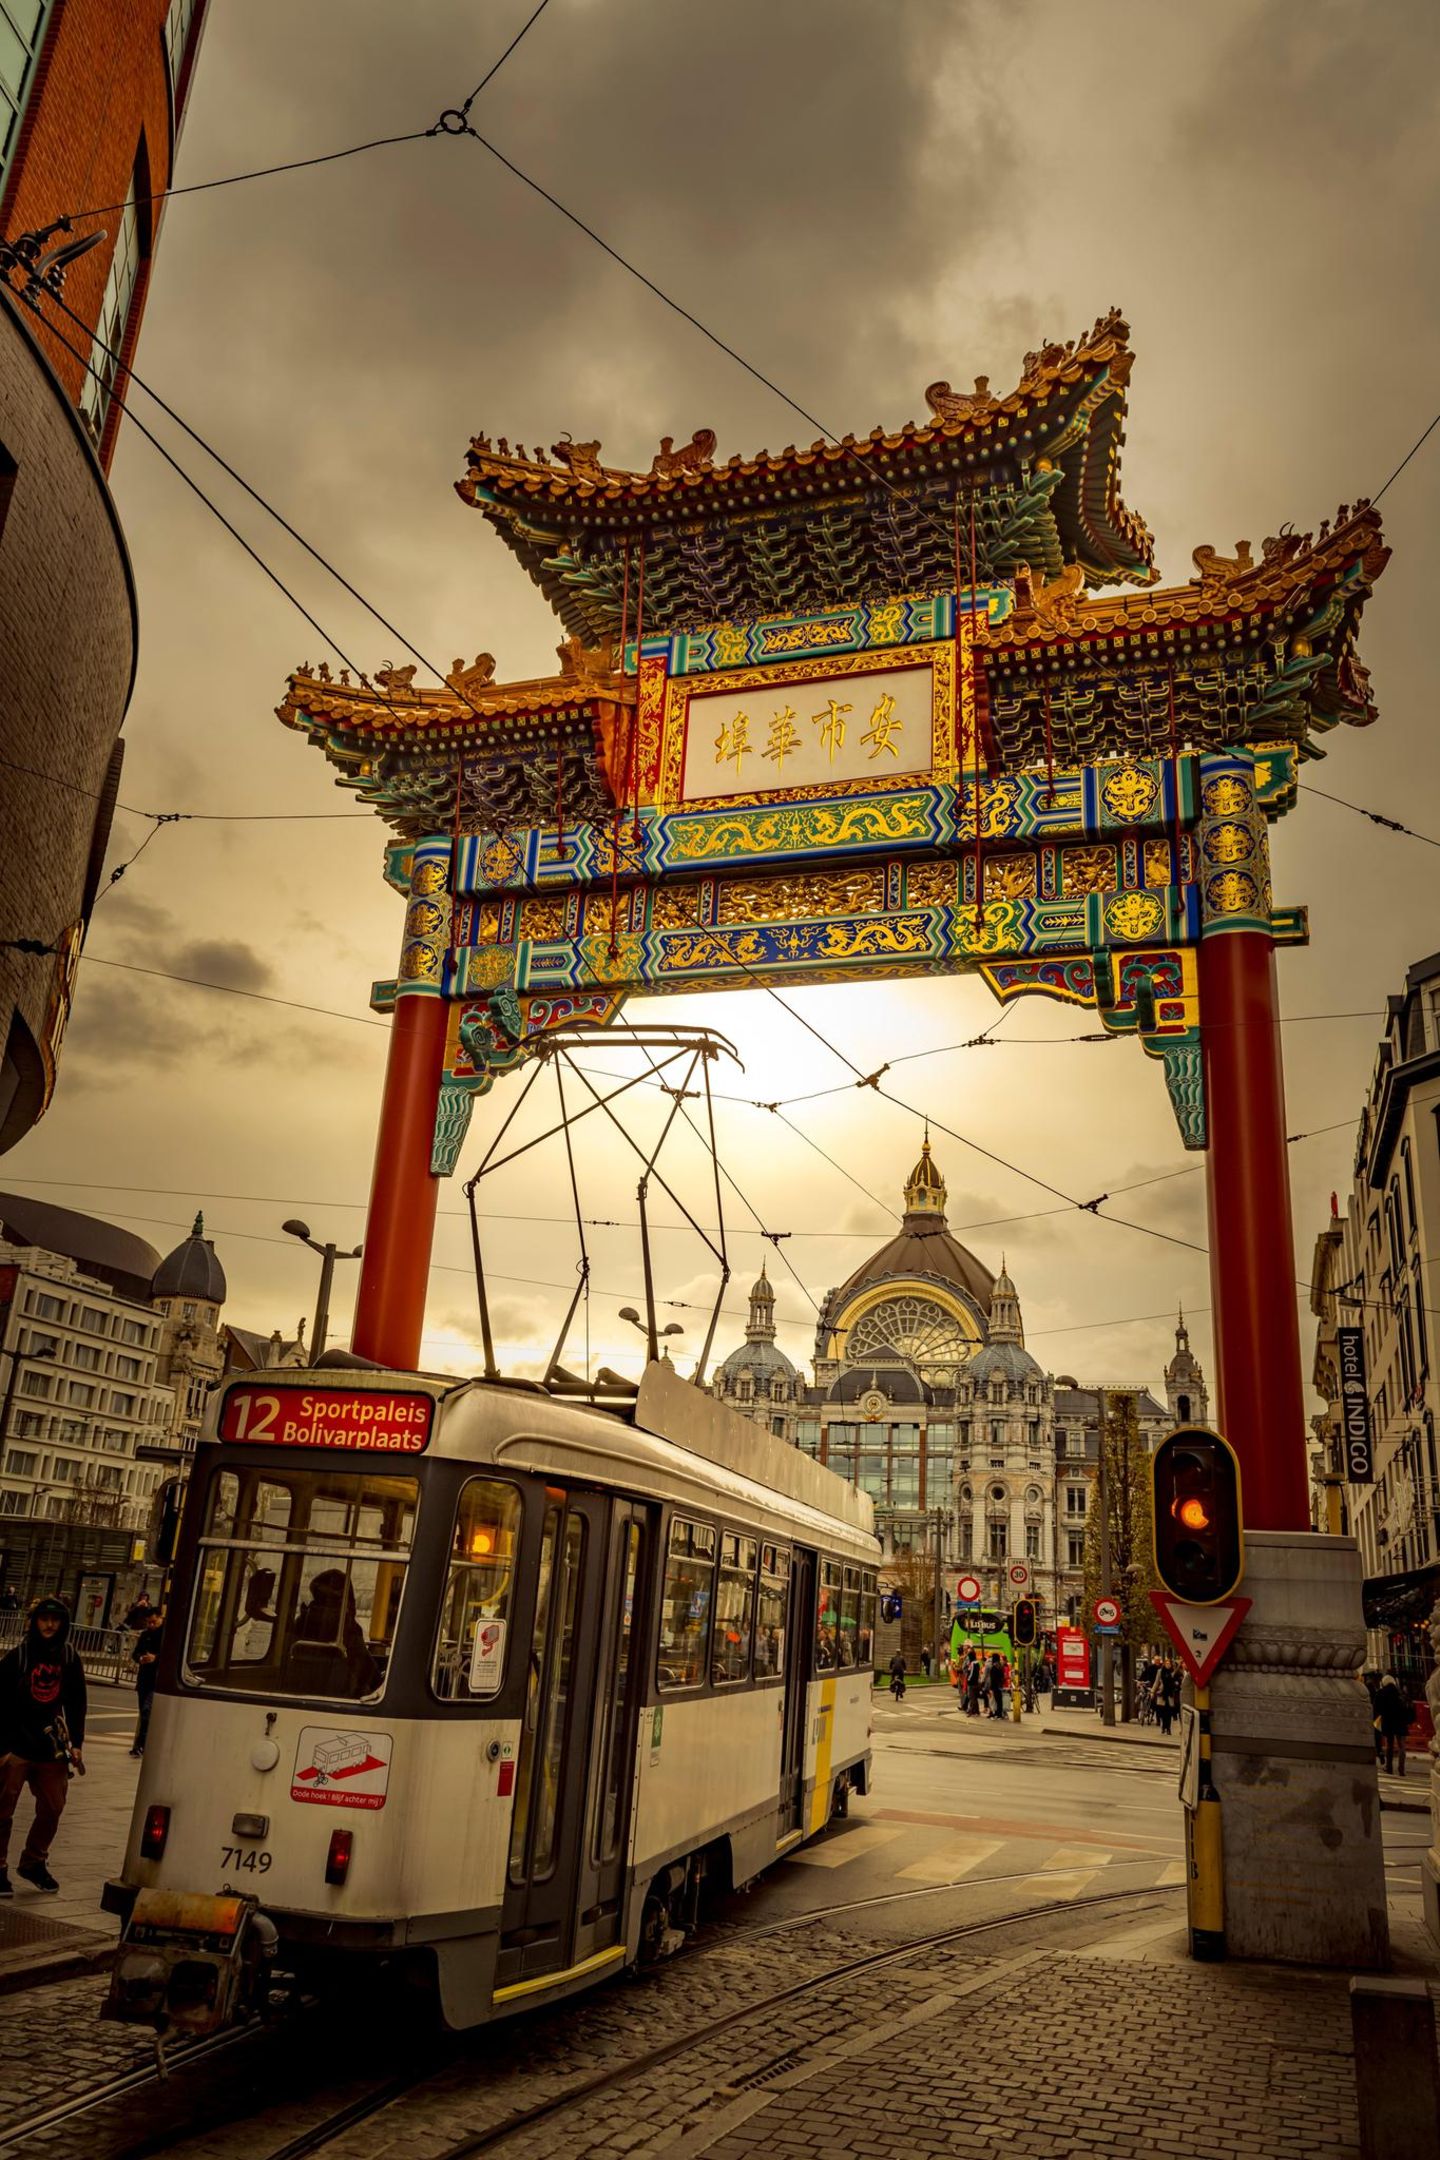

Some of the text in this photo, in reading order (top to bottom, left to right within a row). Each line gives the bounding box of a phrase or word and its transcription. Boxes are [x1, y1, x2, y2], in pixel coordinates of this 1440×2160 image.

[233, 1395, 280, 1441] 12
[300, 1396, 426, 1424] Sportpaleis
[1342, 1335, 1369, 1474] hotel INDIGO
[283, 1421, 422, 1450] Bolivarplaats
[1014, 1570, 1024, 1579] 30
[292, 1789, 309, 1798] Dode
[345, 1795, 366, 1804] achter
[221, 1846, 272, 1874] 7149
